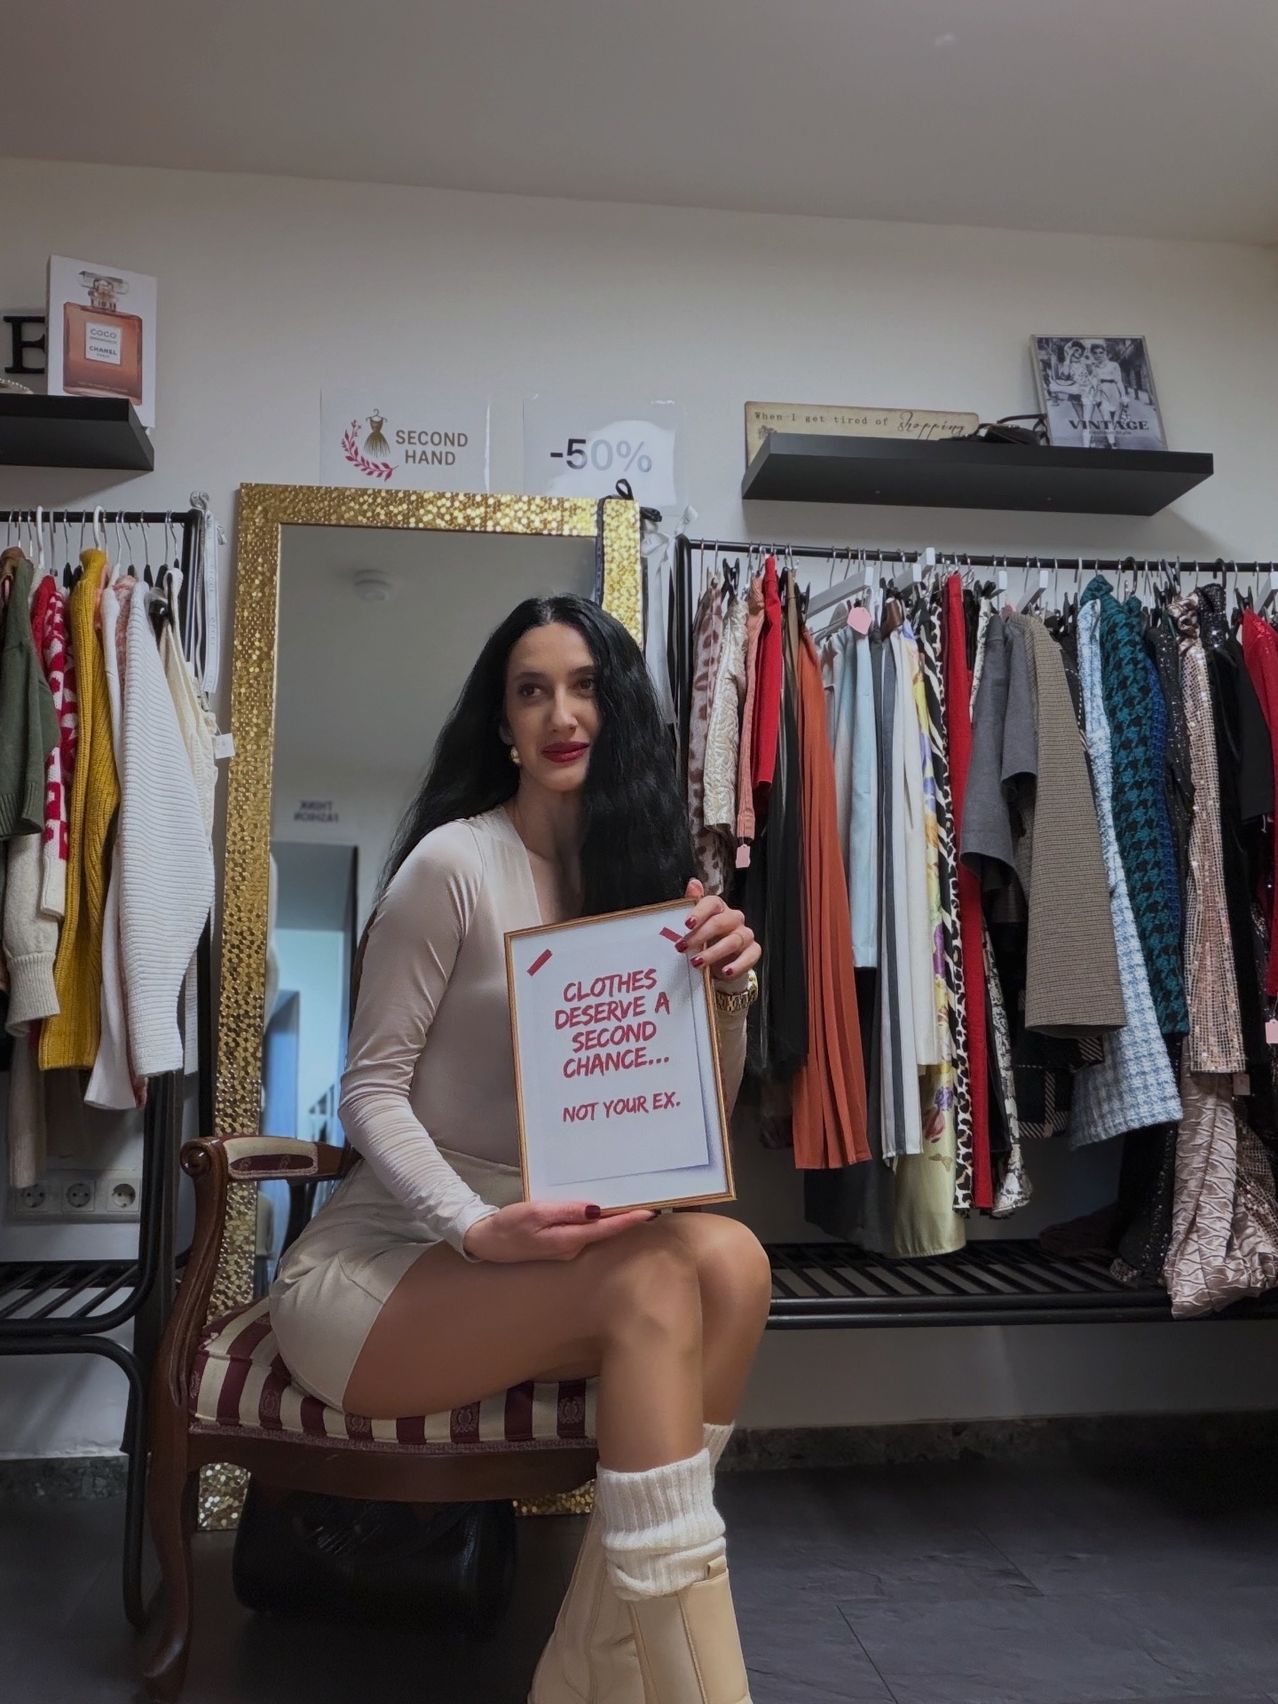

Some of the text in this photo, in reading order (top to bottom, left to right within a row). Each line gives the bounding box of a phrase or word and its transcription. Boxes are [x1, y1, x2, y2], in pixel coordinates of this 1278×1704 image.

[90, 328, 117, 339] COCO
[89, 345, 117, 356] CHANEL
[755, 411, 782, 421] When
[791, 413, 796, 422] I
[805, 416, 825, 424] get
[834, 416, 867, 425] tired
[875, 417, 888, 426] of
[1069, 419, 1150, 431] VINTAGE
[395, 429, 469, 448] SECOND
[405, 448, 456, 467] HAND
[549, 438, 653, 473] -50%
[563, 968, 657, 1003] CLOTHES
[554, 991, 671, 1030] DESERVE A
[572, 1020, 657, 1054] SECOND
[563, 1047, 670, 1079] CHANCE...
[562, 1091, 681, 1123] NOT YOUR EX.
